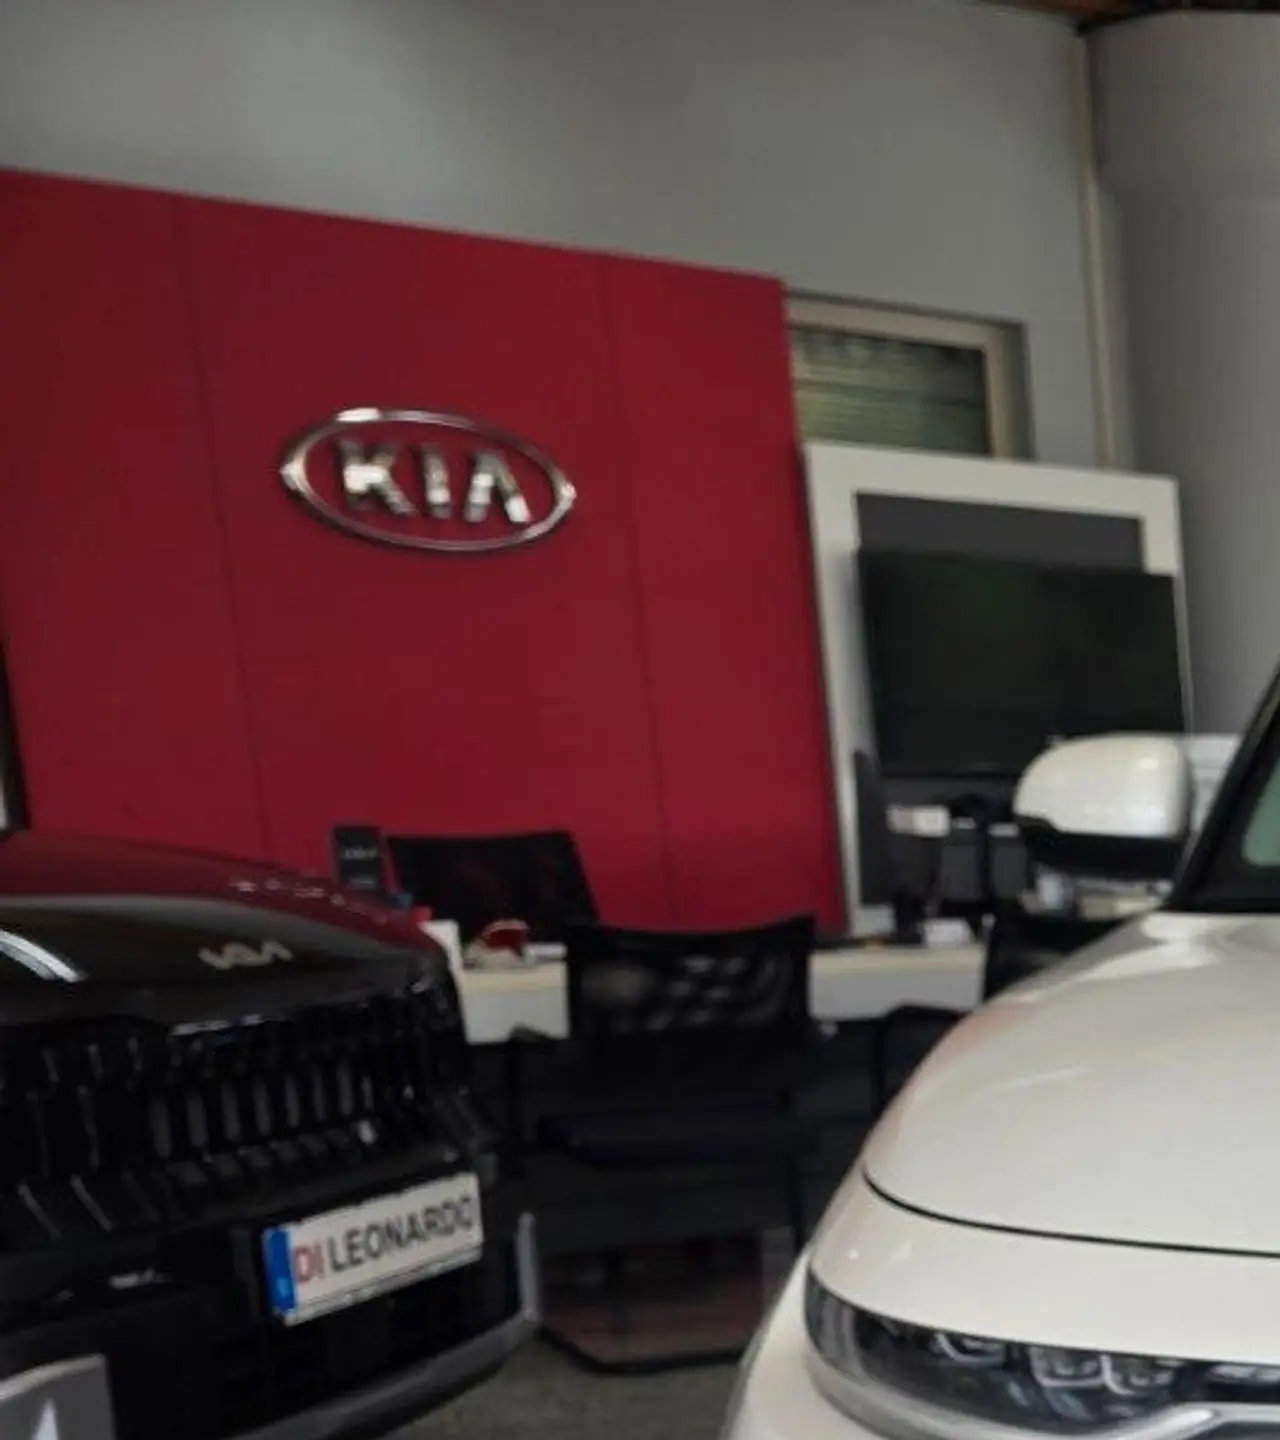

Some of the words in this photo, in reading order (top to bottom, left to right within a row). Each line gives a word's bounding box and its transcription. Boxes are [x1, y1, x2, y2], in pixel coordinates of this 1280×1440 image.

[338, 438, 532, 523] KIA
[295, 1243, 326, 1284] DI
[326, 1192, 475, 1273] LEONARDO
